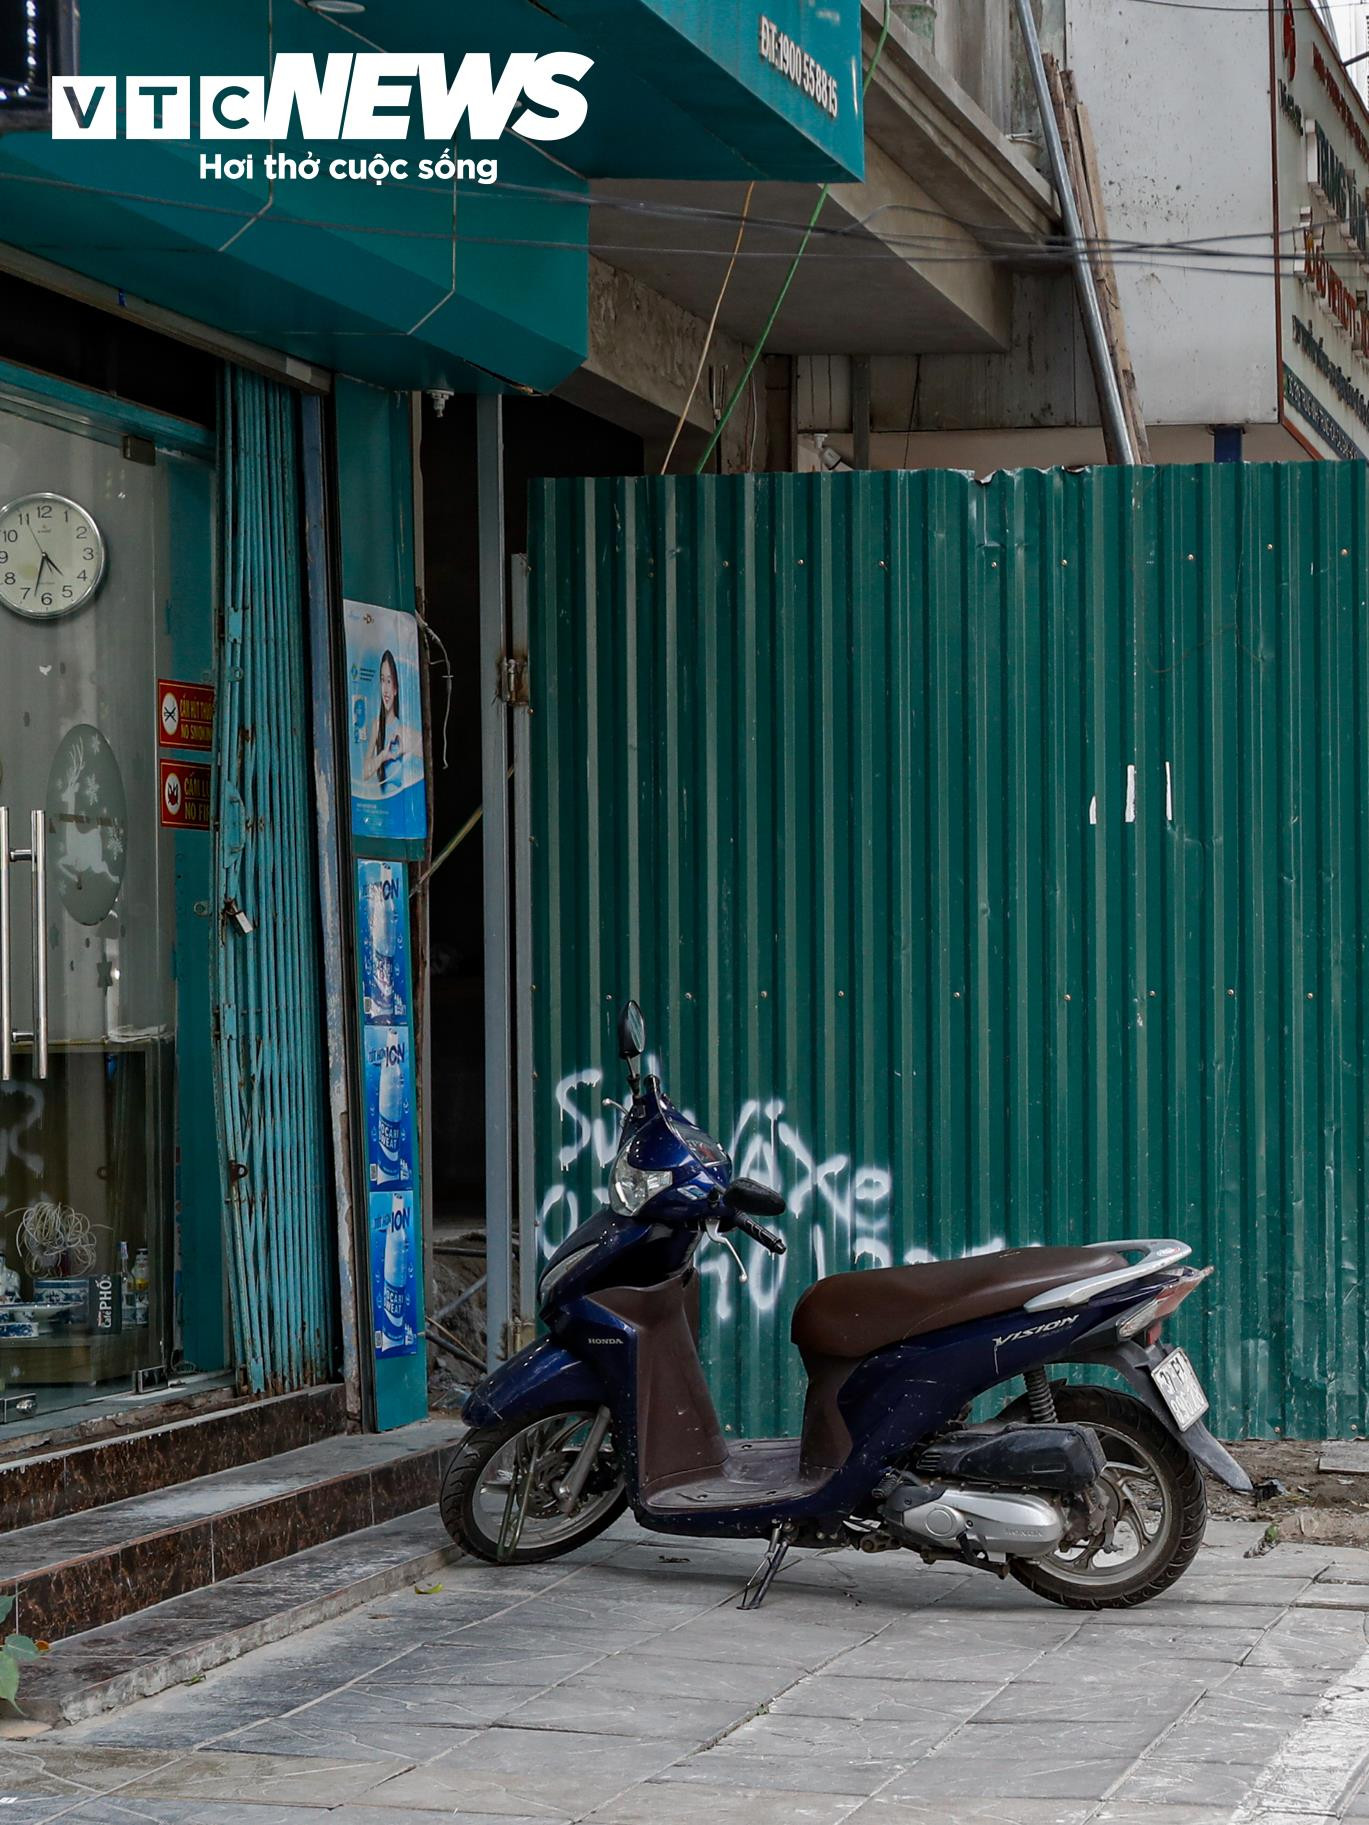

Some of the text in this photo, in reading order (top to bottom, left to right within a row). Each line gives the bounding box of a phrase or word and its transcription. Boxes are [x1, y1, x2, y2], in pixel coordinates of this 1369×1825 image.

[37, 505, 53, 519] 12
[64, 510, 69, 523] 1
[18, 513, 30, 526] 11
[3, 529, 18, 542] 10
[76, 526, 88, 539] 2
[0, 550, 9, 564] 9
[82, 547, 95, 560] 3
[4, 572, 16, 585] 8
[76, 569, 88, 582] 4
[20, 587, 32, 600] 7
[62, 585, 74, 598] 5
[41, 592, 53, 606] 6
[180, 723, 190, 739] NO
[184, 801, 197, 821] NO
[385, 1042, 405, 1068] ION
[391, 1207, 410, 1232] ION
[991, 1314, 1080, 1352] VISION
